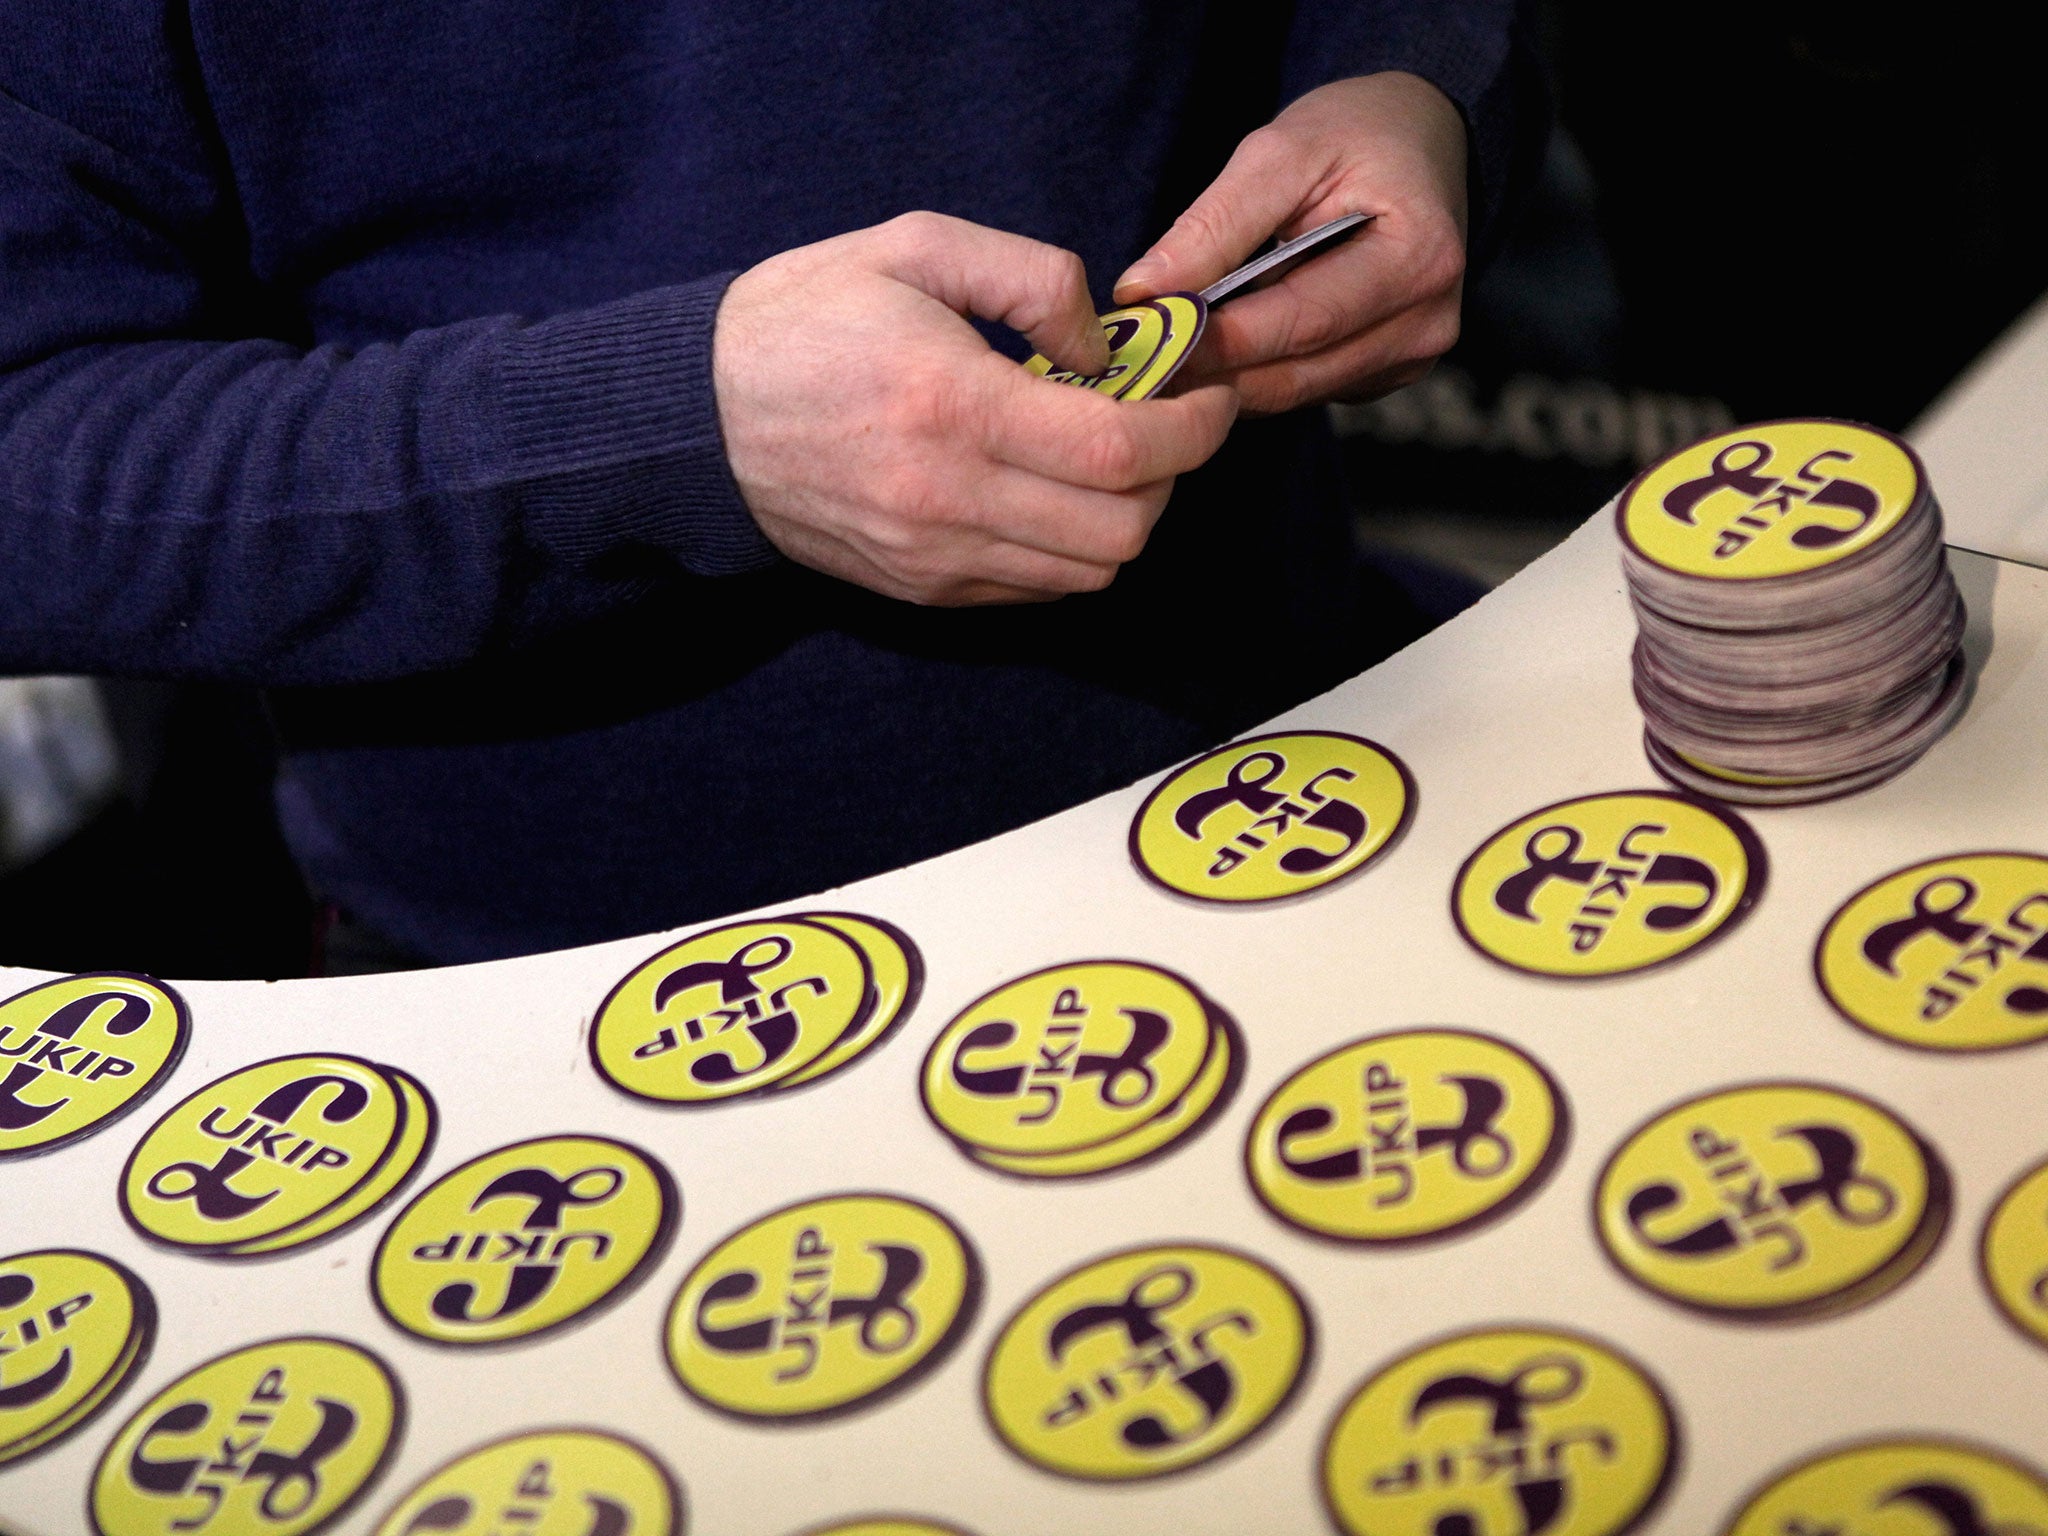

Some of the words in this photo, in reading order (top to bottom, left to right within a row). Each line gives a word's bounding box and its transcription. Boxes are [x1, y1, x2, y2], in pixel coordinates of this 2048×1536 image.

[1715, 451, 1854, 557] UKIP
[1208, 767, 1356, 878] UKIP
[1570, 823, 1666, 954] UKIP
[0, 1026, 135, 1081] UKIP
[634, 977, 828, 1059] UKIP
[1018, 988, 1088, 1125] UKIP
[200, 1106, 349, 1172] UKIP
[1364, 1062, 1412, 1208] UKIP
[413, 1232, 612, 1263] UKIP
[1690, 1130, 1805, 1273] UKIP
[0, 1294, 93, 1354] IP
[776, 1229, 833, 1382] UKIP
[1044, 1312, 1253, 1426] UKIP
[172, 1367, 286, 1530] UKIP
